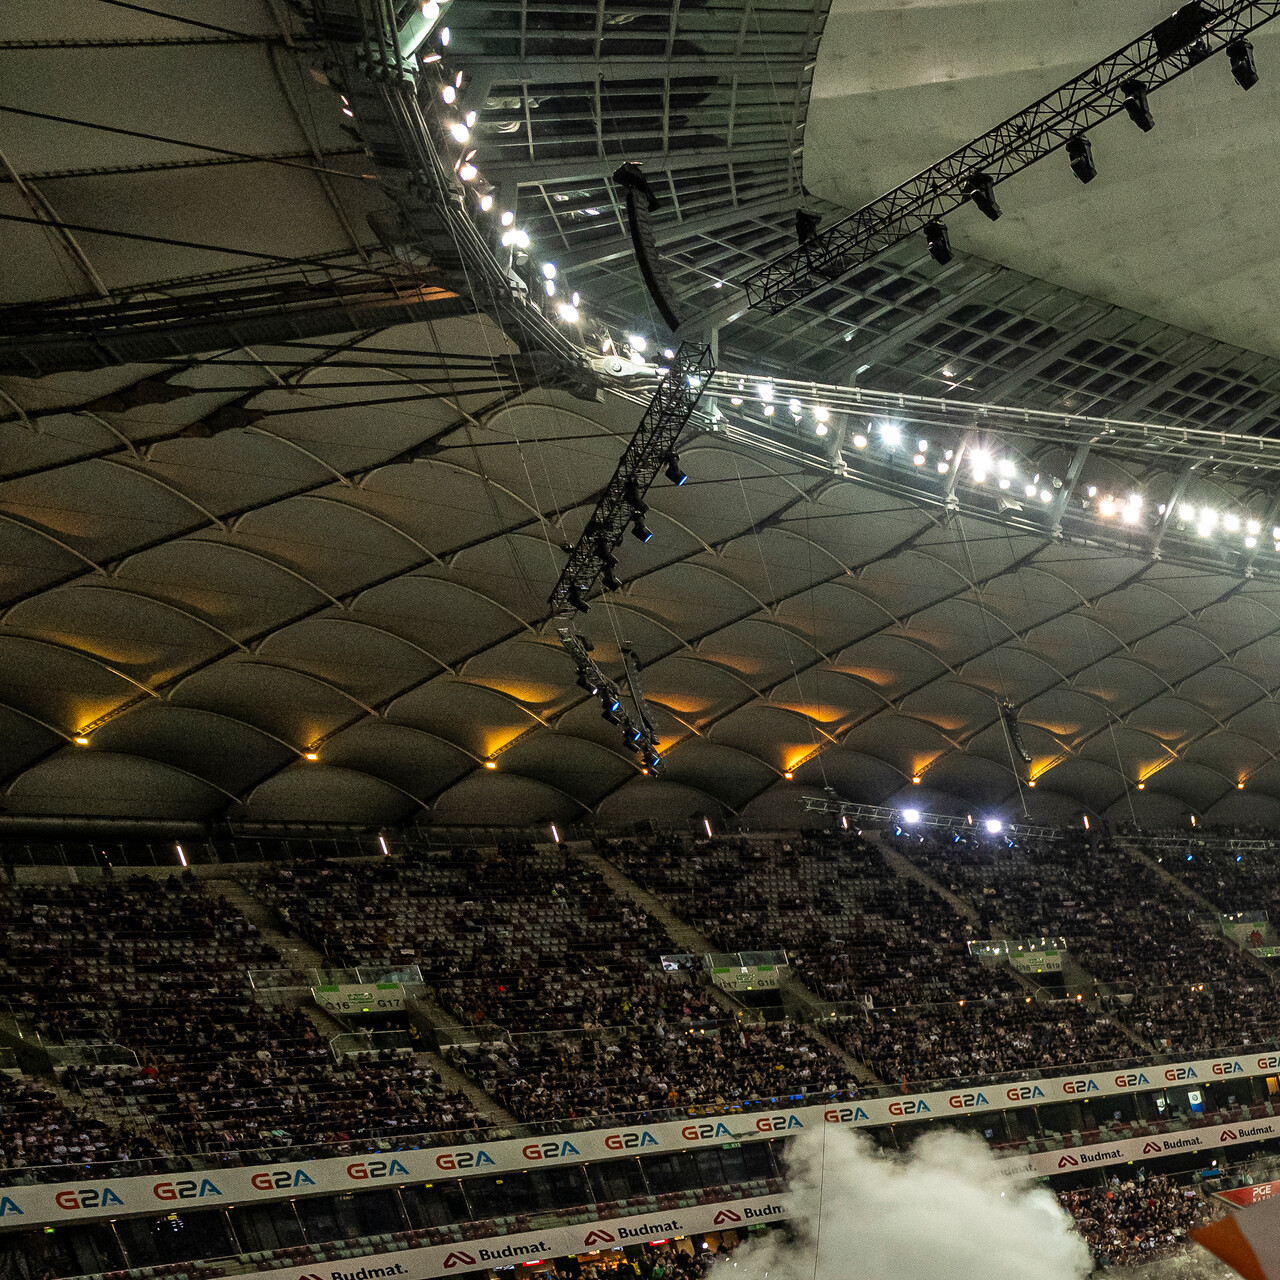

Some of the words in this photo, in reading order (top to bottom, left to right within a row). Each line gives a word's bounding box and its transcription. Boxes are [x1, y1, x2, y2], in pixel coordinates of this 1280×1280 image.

[1212, 1062, 1242, 1075] G2A
[1063, 1080, 1098, 1094] G2A
[1115, 1074, 1148, 1087] G2A
[889, 1101, 930, 1115] G2A
[949, 1093, 988, 1108] G2A
[756, 1115, 804, 1132] G2A
[824, 1108, 868, 1122] G2A
[682, 1123, 735, 1140] G2A
[1239, 1126, 1274, 1137] Budmat.
[605, 1132, 657, 1150] G2A
[1163, 1137, 1202, 1149] Budmat.
[523, 1141, 579, 1160] G2A
[1080, 1150, 1121, 1163] Budmat.
[436, 1151, 494, 1170] G2A
[347, 1160, 408, 1179] G2A
[251, 1170, 314, 1190] G2A
[154, 1179, 221, 1200] G2A
[1253, 1185, 1271, 1195] PGE
[55, 1188, 123, 1210] G2A
[618, 1221, 683, 1238] Budmat.
[479, 1242, 551, 1261] Budmat.
